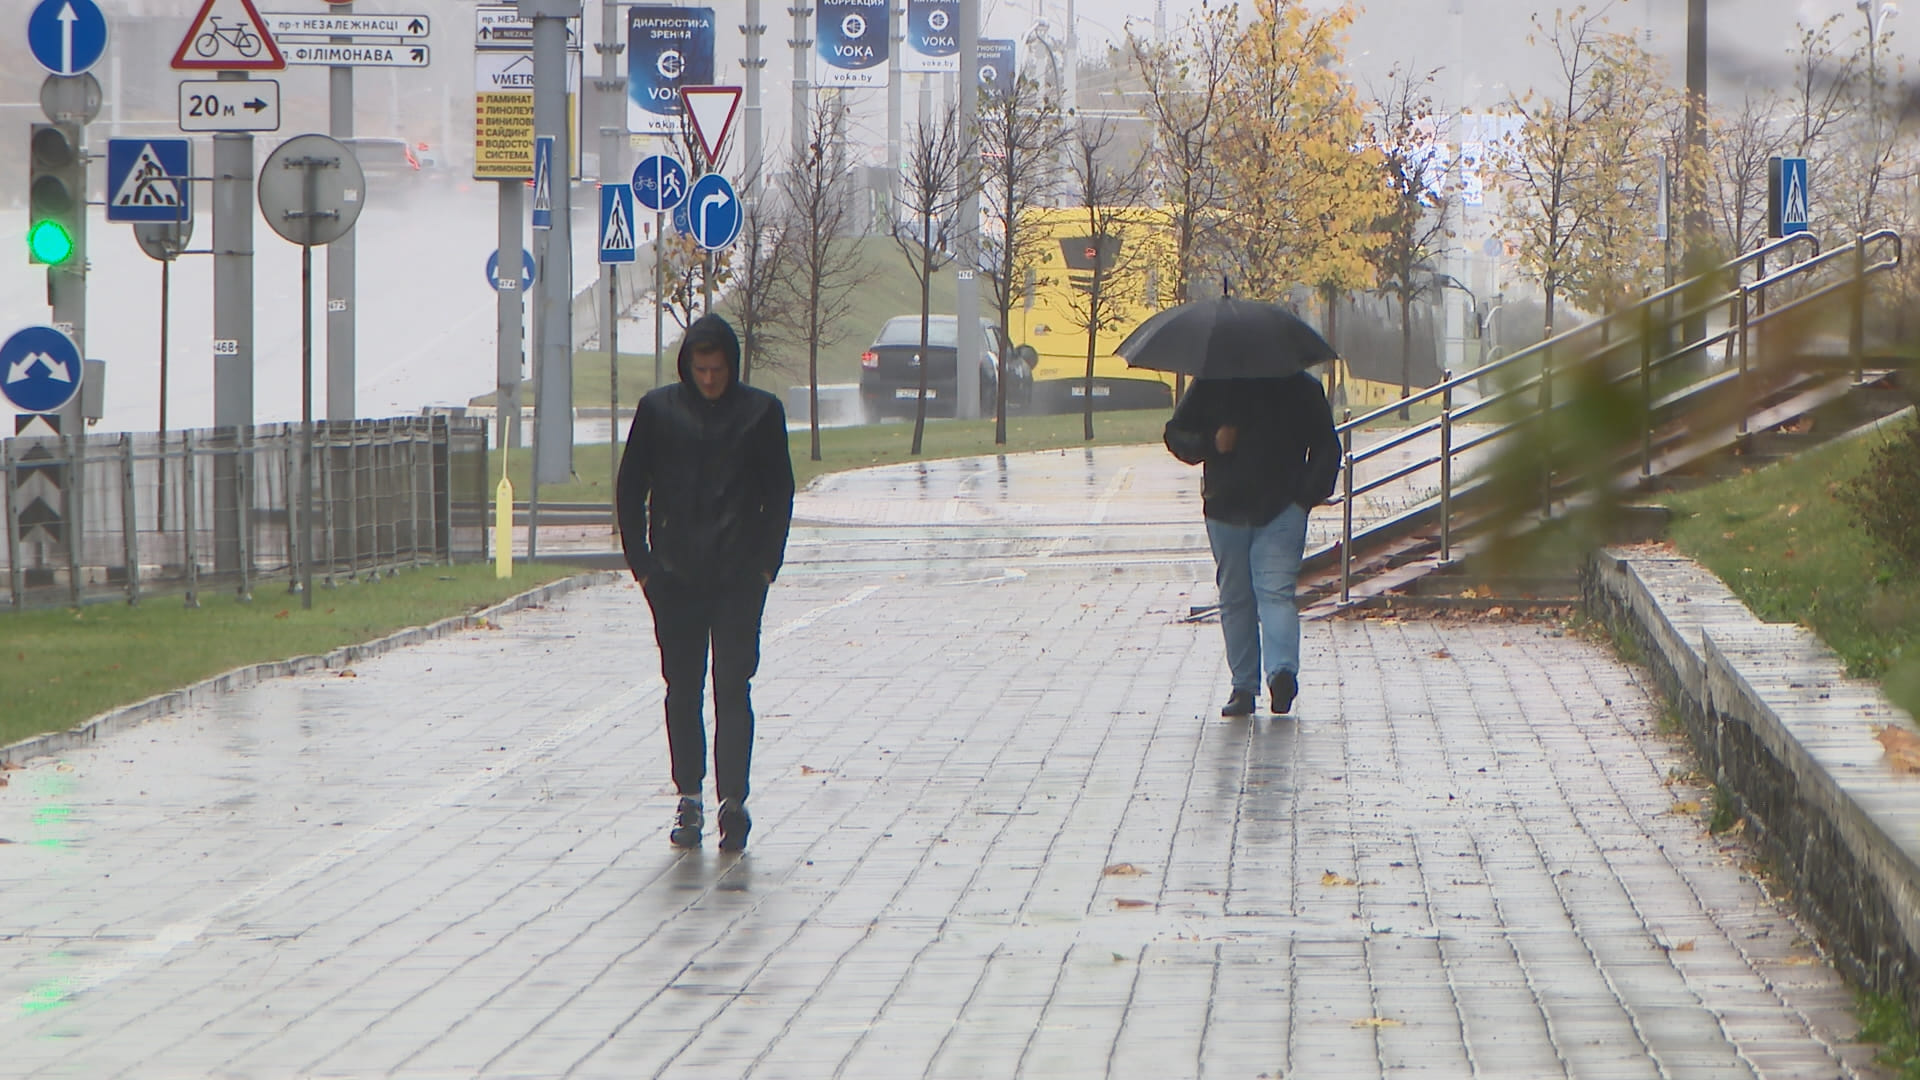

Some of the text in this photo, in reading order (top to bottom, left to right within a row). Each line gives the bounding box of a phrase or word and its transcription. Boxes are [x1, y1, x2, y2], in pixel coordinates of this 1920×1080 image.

[303, 20, 398, 31] НЕЗАЛЕЖНАСЦІ
[633, 19, 709, 28] ДИАГНОСТИКА
[650, 30, 692, 39] ЗРЕНИЯ
[921, 36, 955, 46] VOKA
[296, 49, 393, 61] ФІЛІМОНАВА
[833, 45, 874, 57] VOKA
[834, 73, 872, 82] voka.by
[648, 87, 680, 100] VOK
[486, 95, 532, 104] ЛАМИНАТ
[189, 94, 219, 116] 20
[486, 127, 530, 138] САЙДИНГ
[485, 151, 529, 159] СИСТЕМА
[216, 342, 235, 352] 468
